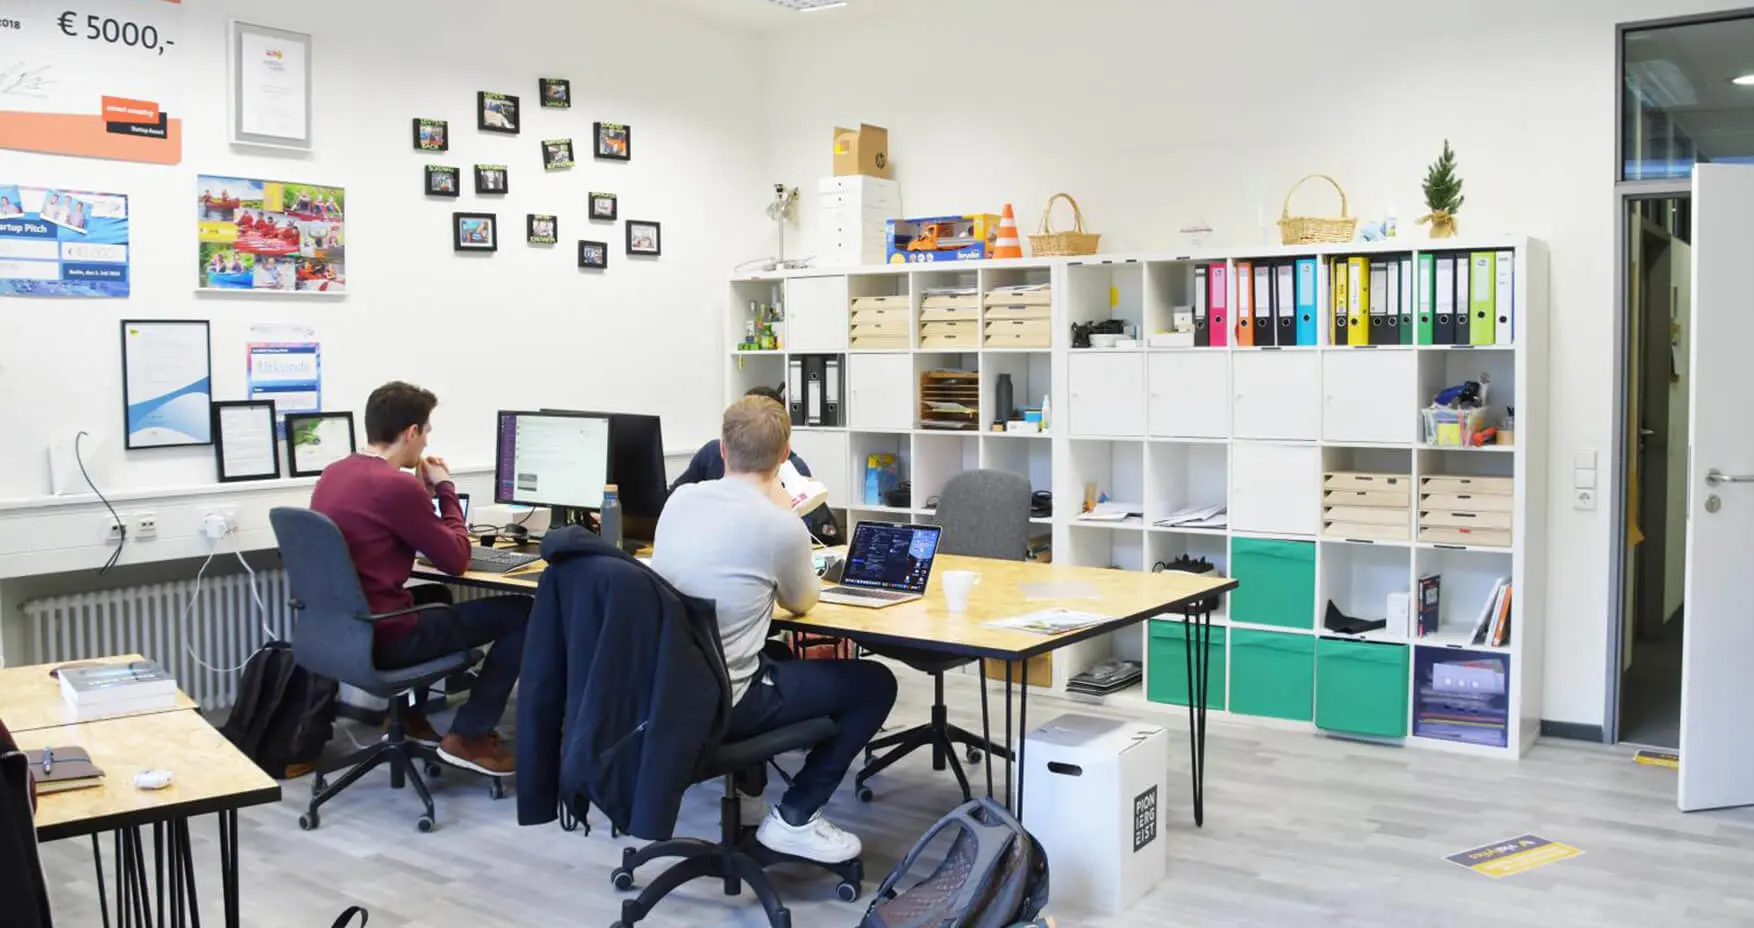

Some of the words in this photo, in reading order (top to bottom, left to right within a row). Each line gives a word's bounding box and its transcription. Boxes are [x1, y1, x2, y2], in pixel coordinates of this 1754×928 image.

[57, 10, 78, 37] €
[87, 15, 175, 56] 5000,-
[24, 223, 48, 234] Pitch
[1136, 791, 1156, 816] PION
